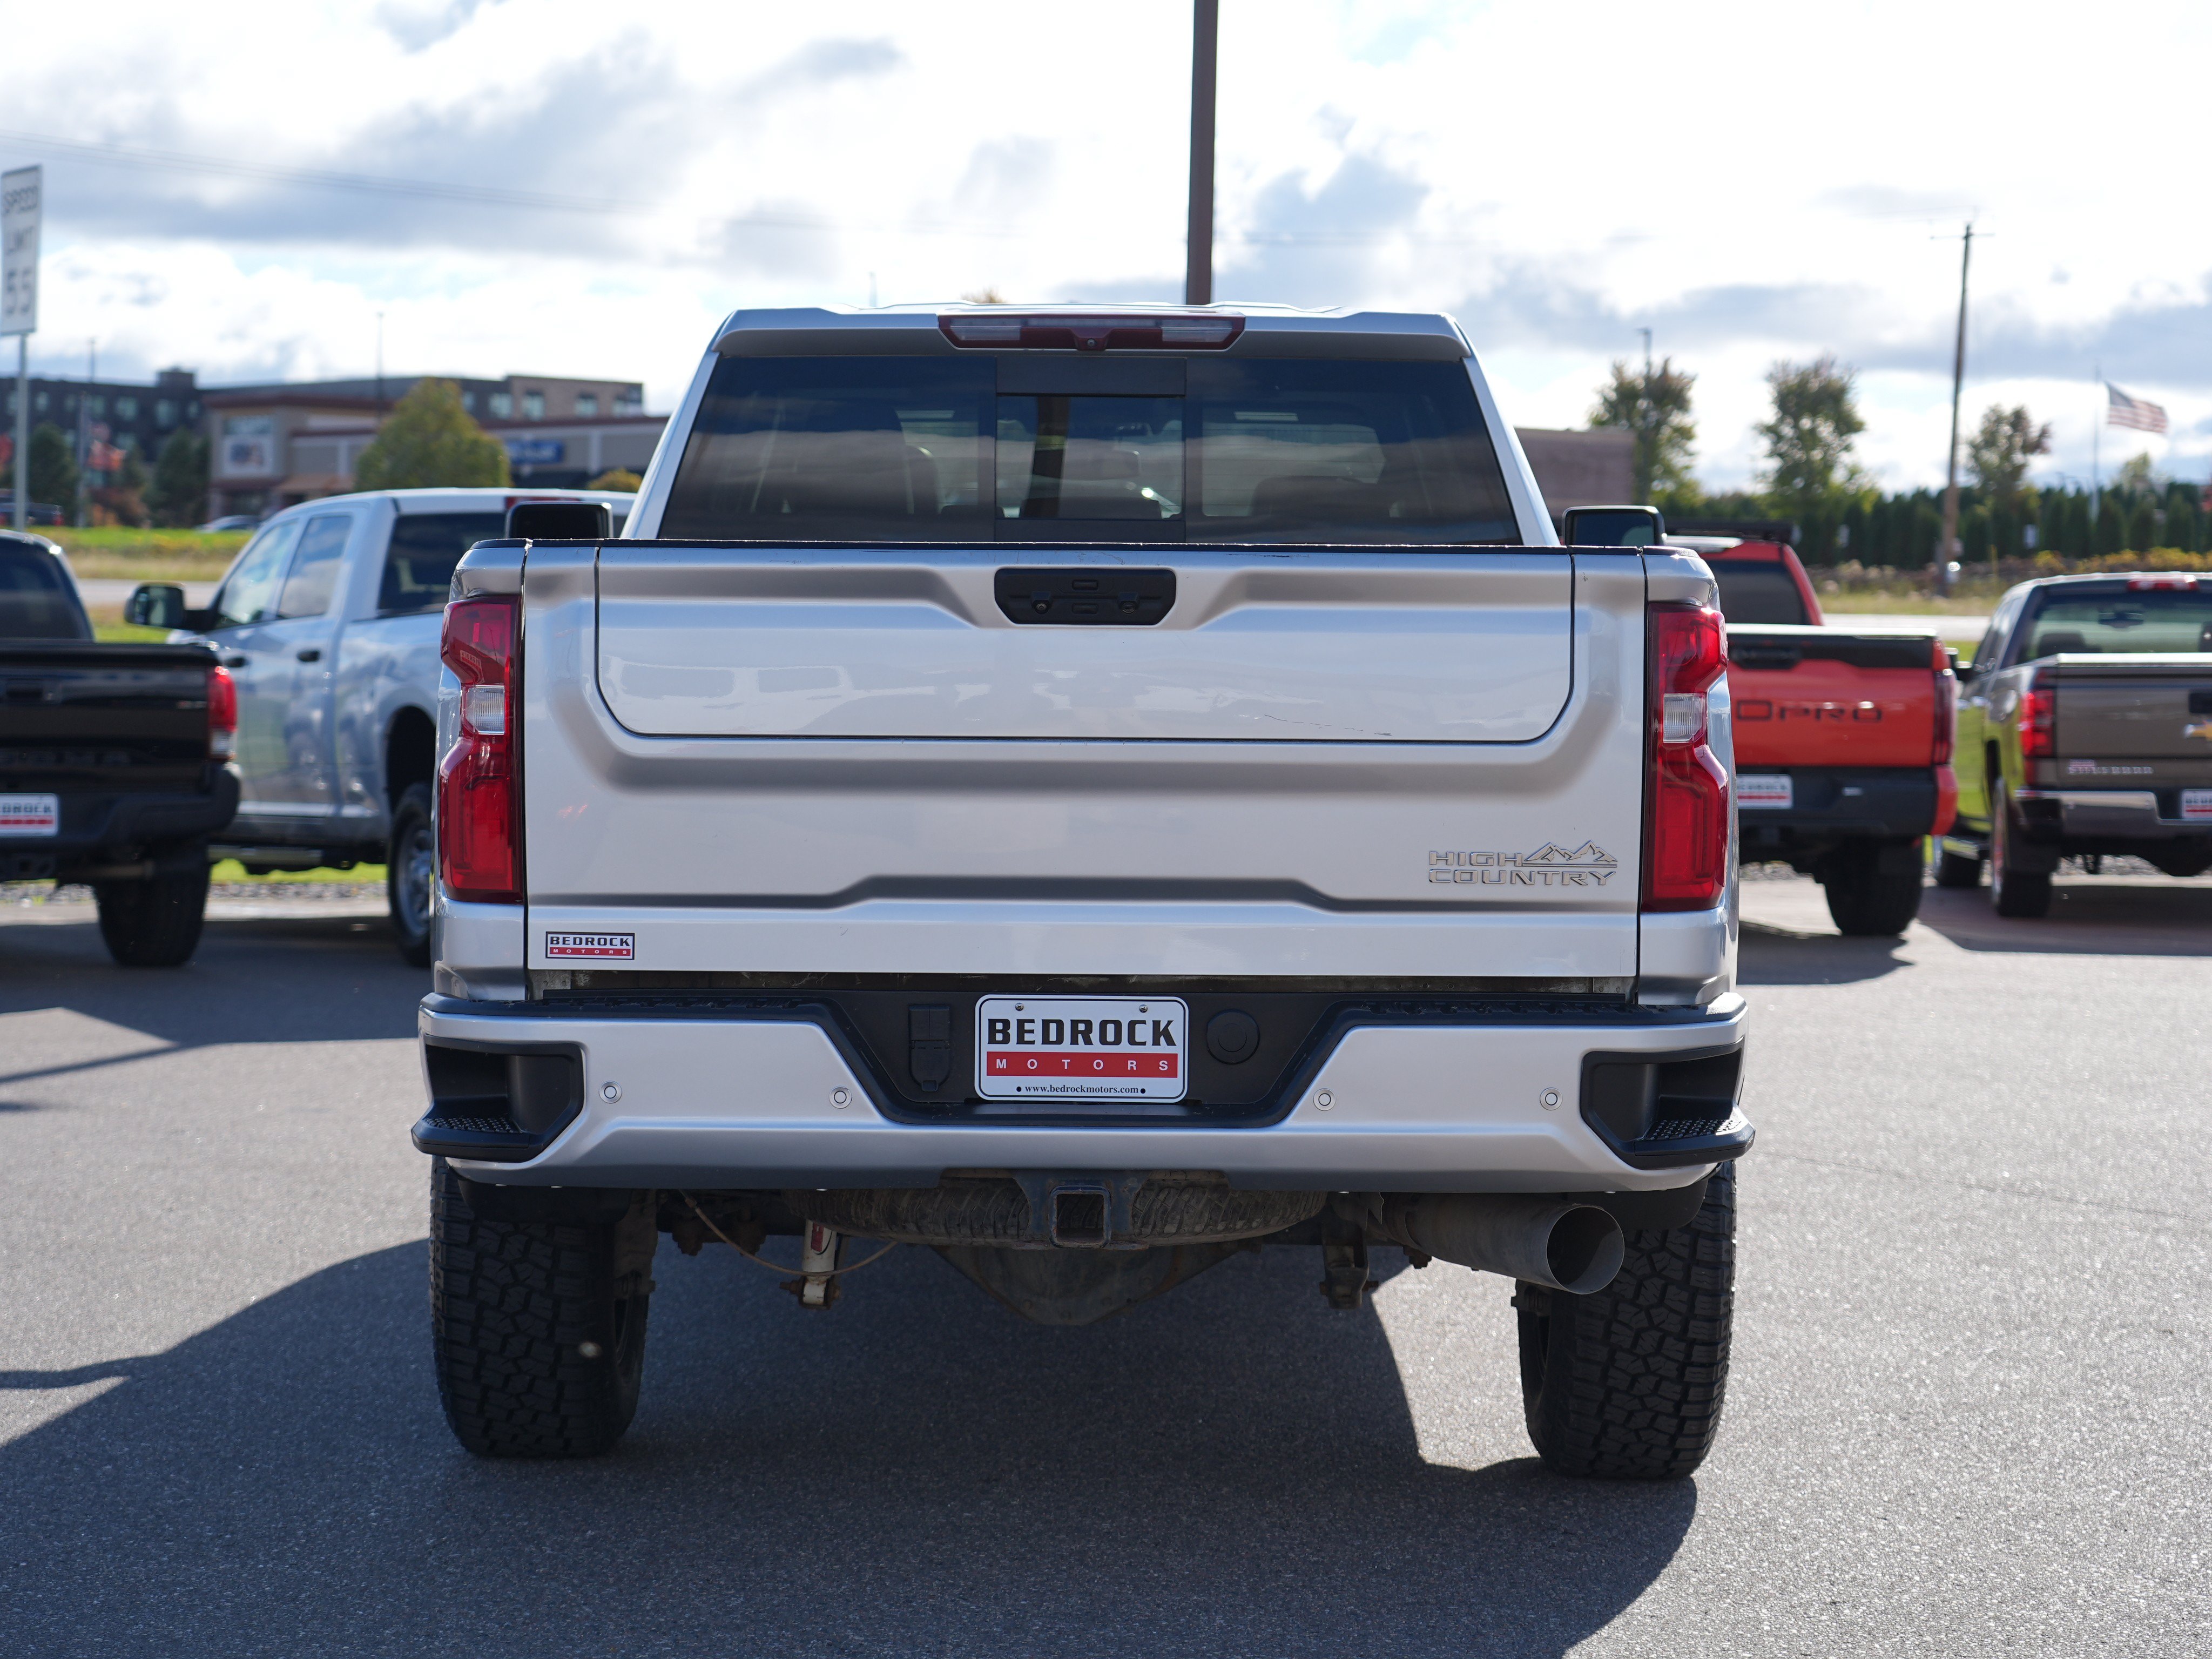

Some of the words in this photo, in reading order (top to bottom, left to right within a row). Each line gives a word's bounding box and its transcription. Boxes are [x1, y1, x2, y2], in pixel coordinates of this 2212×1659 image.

[1429, 851, 1523, 867] HIGH
[1428, 869, 1616, 886] COUNTRY
[550, 936, 630, 946] BEDROCK
[987, 1019, 1177, 1046] BEDROCK
[996, 1059, 1168, 1071] MOTORS
[1025, 1084, 1139, 1094] www.bedrockmotors.com
